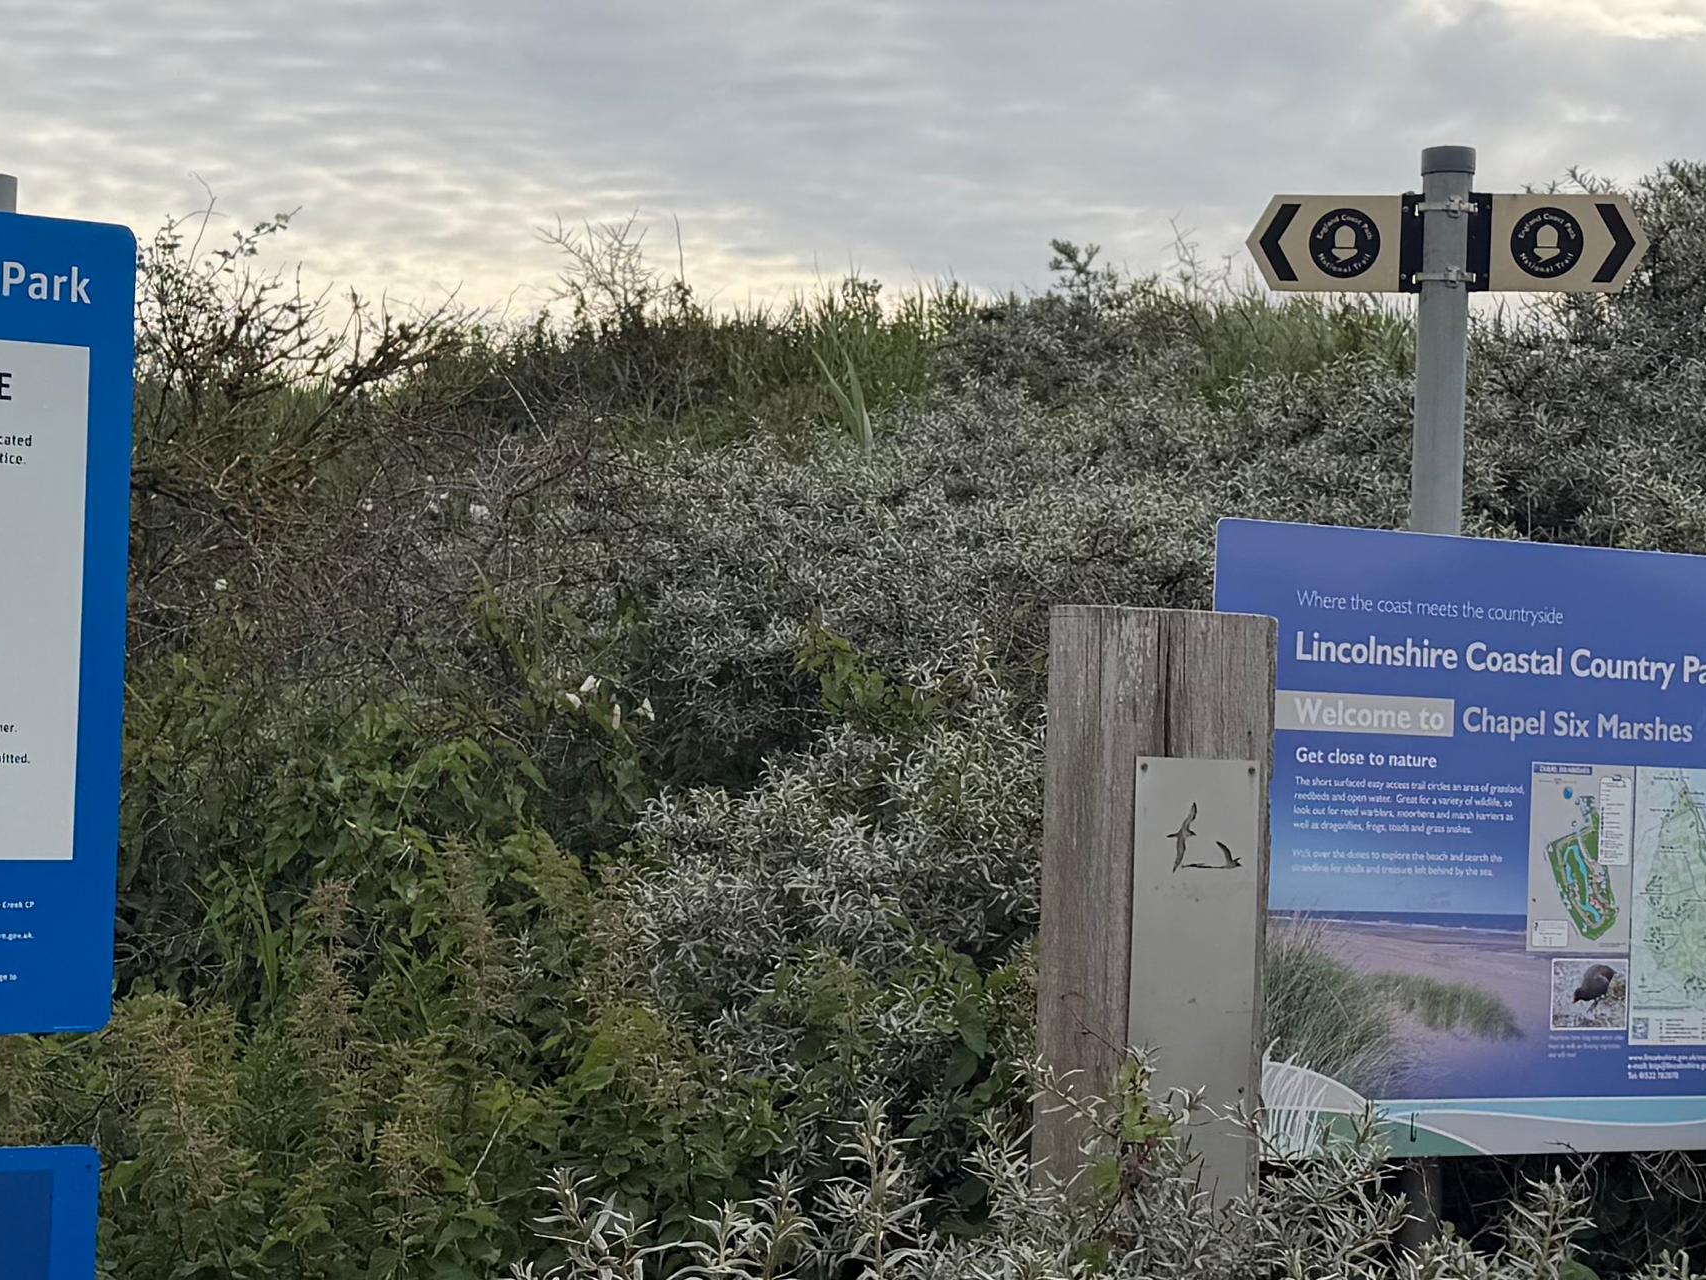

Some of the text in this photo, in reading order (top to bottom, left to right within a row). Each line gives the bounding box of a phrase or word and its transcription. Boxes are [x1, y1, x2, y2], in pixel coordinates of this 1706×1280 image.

[2, 260, 91, 305] Park
[1318, 252, 1372, 273] National Trail
[1520, 252, 1574, 273] National Trail
[1296, 588, 1564, 628] Where the coast meets the countryside
[1296, 630, 1458, 670] Lincolnshire
[1465, 641, 1563, 676] Coastal
[1570, 647, 1676, 691] Country
[1294, 697, 1693, 744] Welcome to Chapel Six Marshes
[1295, 745, 1438, 770] Get close to nature
